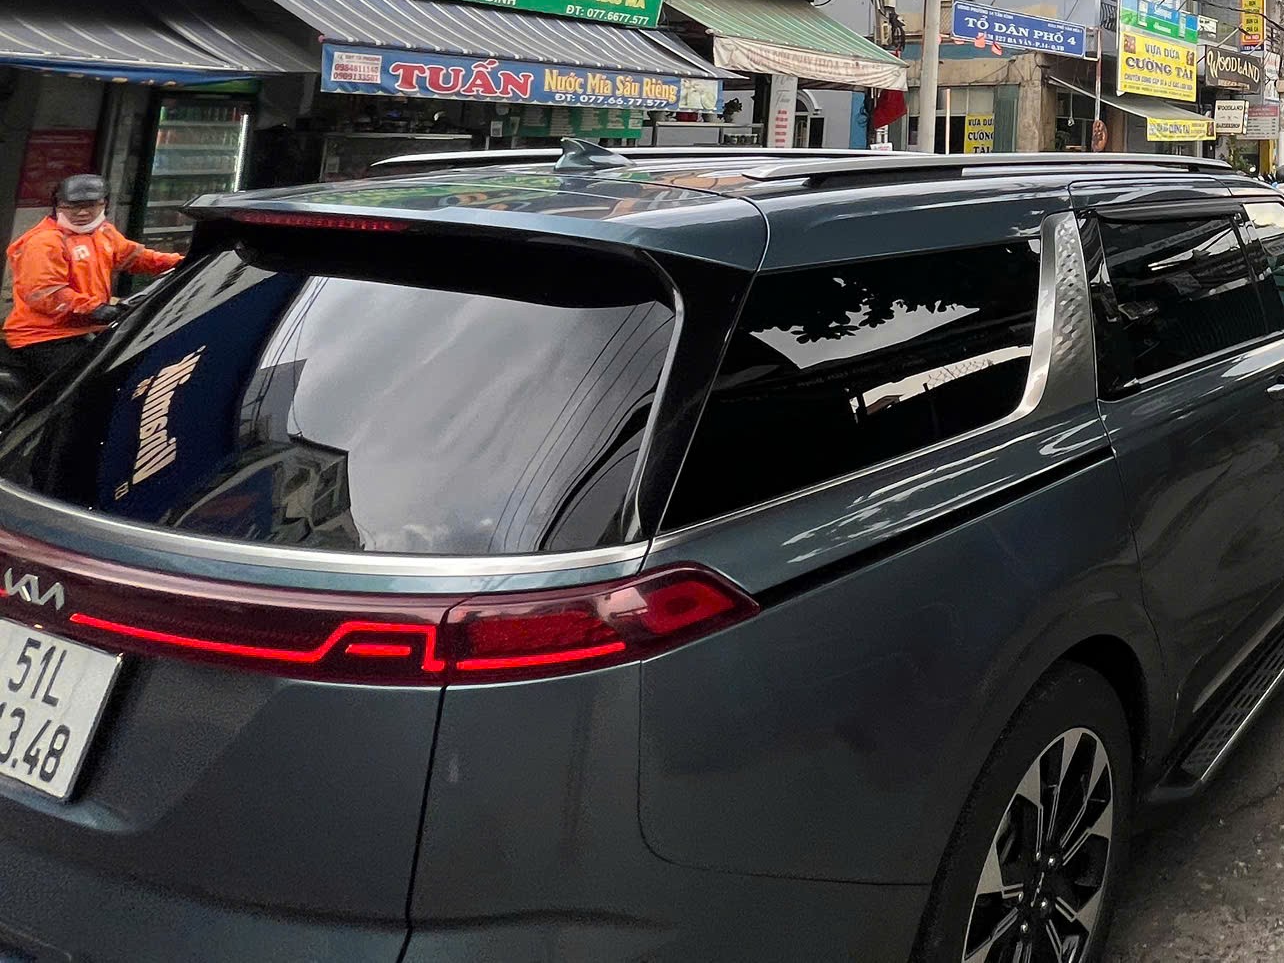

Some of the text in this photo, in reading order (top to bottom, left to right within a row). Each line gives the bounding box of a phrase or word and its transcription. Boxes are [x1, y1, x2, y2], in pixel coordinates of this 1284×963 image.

[566, 5, 649, 25] ĐT: 077.6677.577
[964, 15, 1077, 46] TỔ DÂN PHỐ 4
[1125, 56, 1193, 80] CƯỜNG TÀI
[1206, 50, 1260, 83] WOODLAND
[389, 59, 534, 99] TUẤN
[544, 68, 584, 93] Nước
[642, 77, 678, 104] Riêng
[555, 93, 668, 107] ĐT: 077.66.77.577
[983, 117, 993, 126] DỪ
[8, 637, 67, 707] 51L
